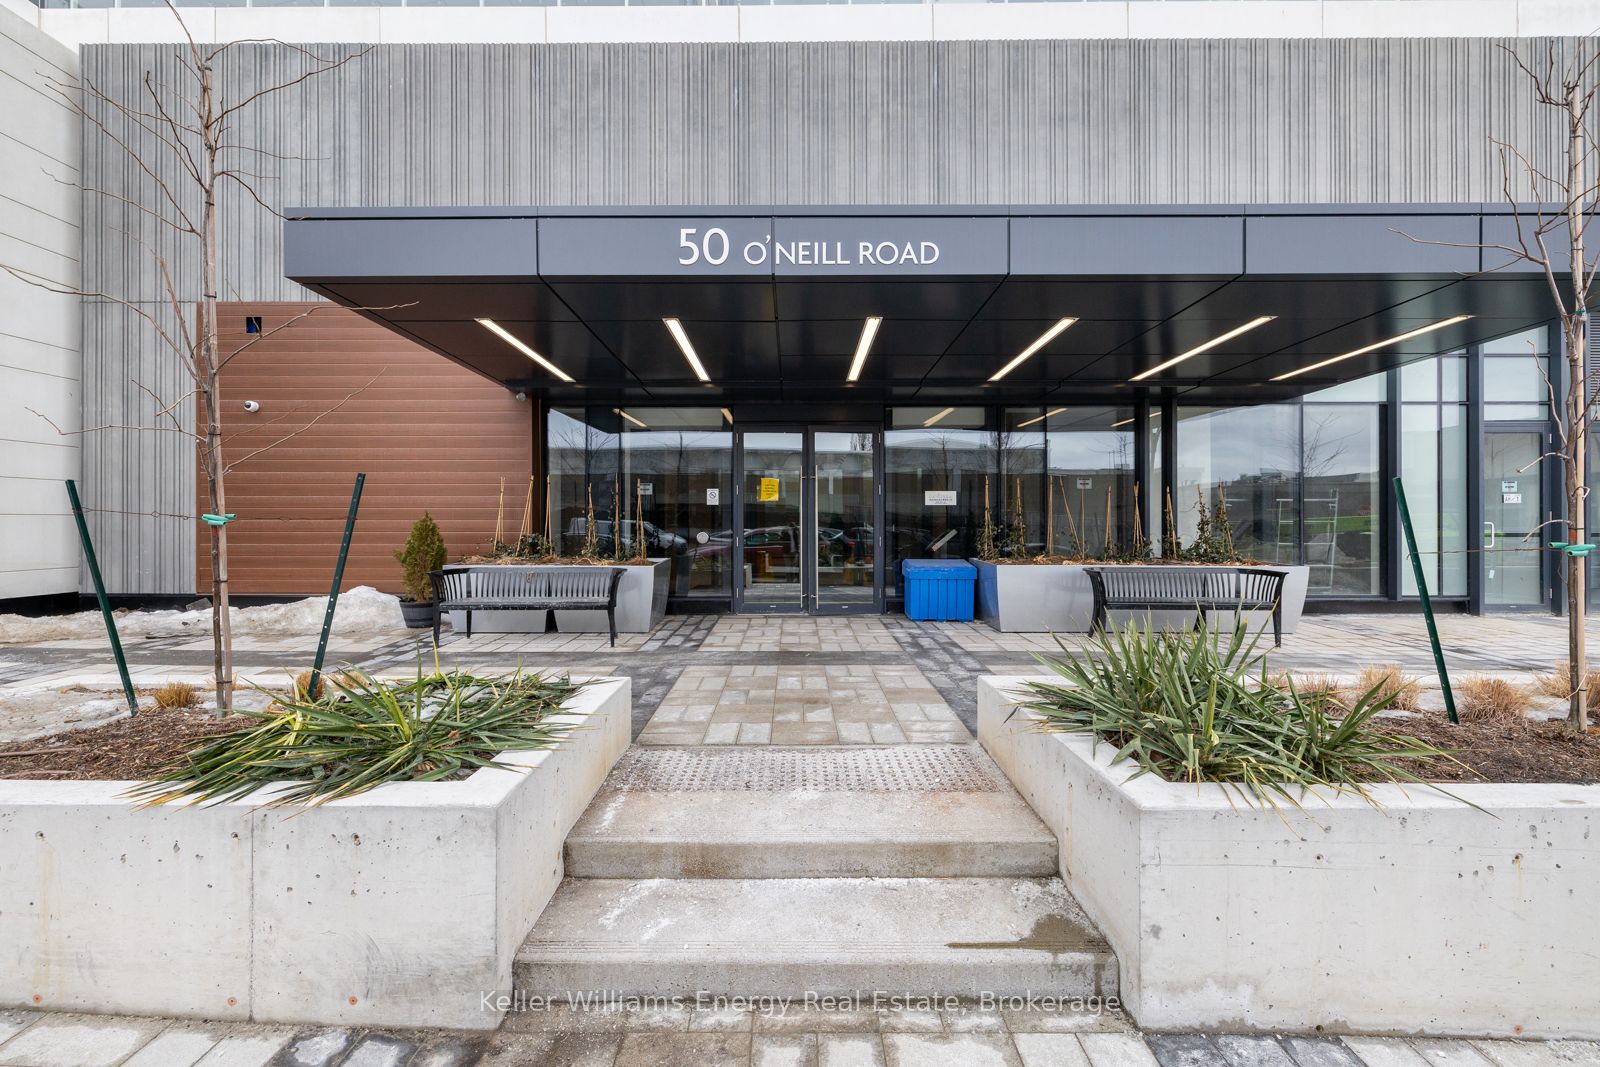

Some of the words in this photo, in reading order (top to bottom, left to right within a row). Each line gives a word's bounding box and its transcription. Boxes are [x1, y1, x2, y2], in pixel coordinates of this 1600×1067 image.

[678, 227, 730, 265] 50
[743, 234, 850, 265] O'NEILL
[858, 241, 940, 265] ROAD
